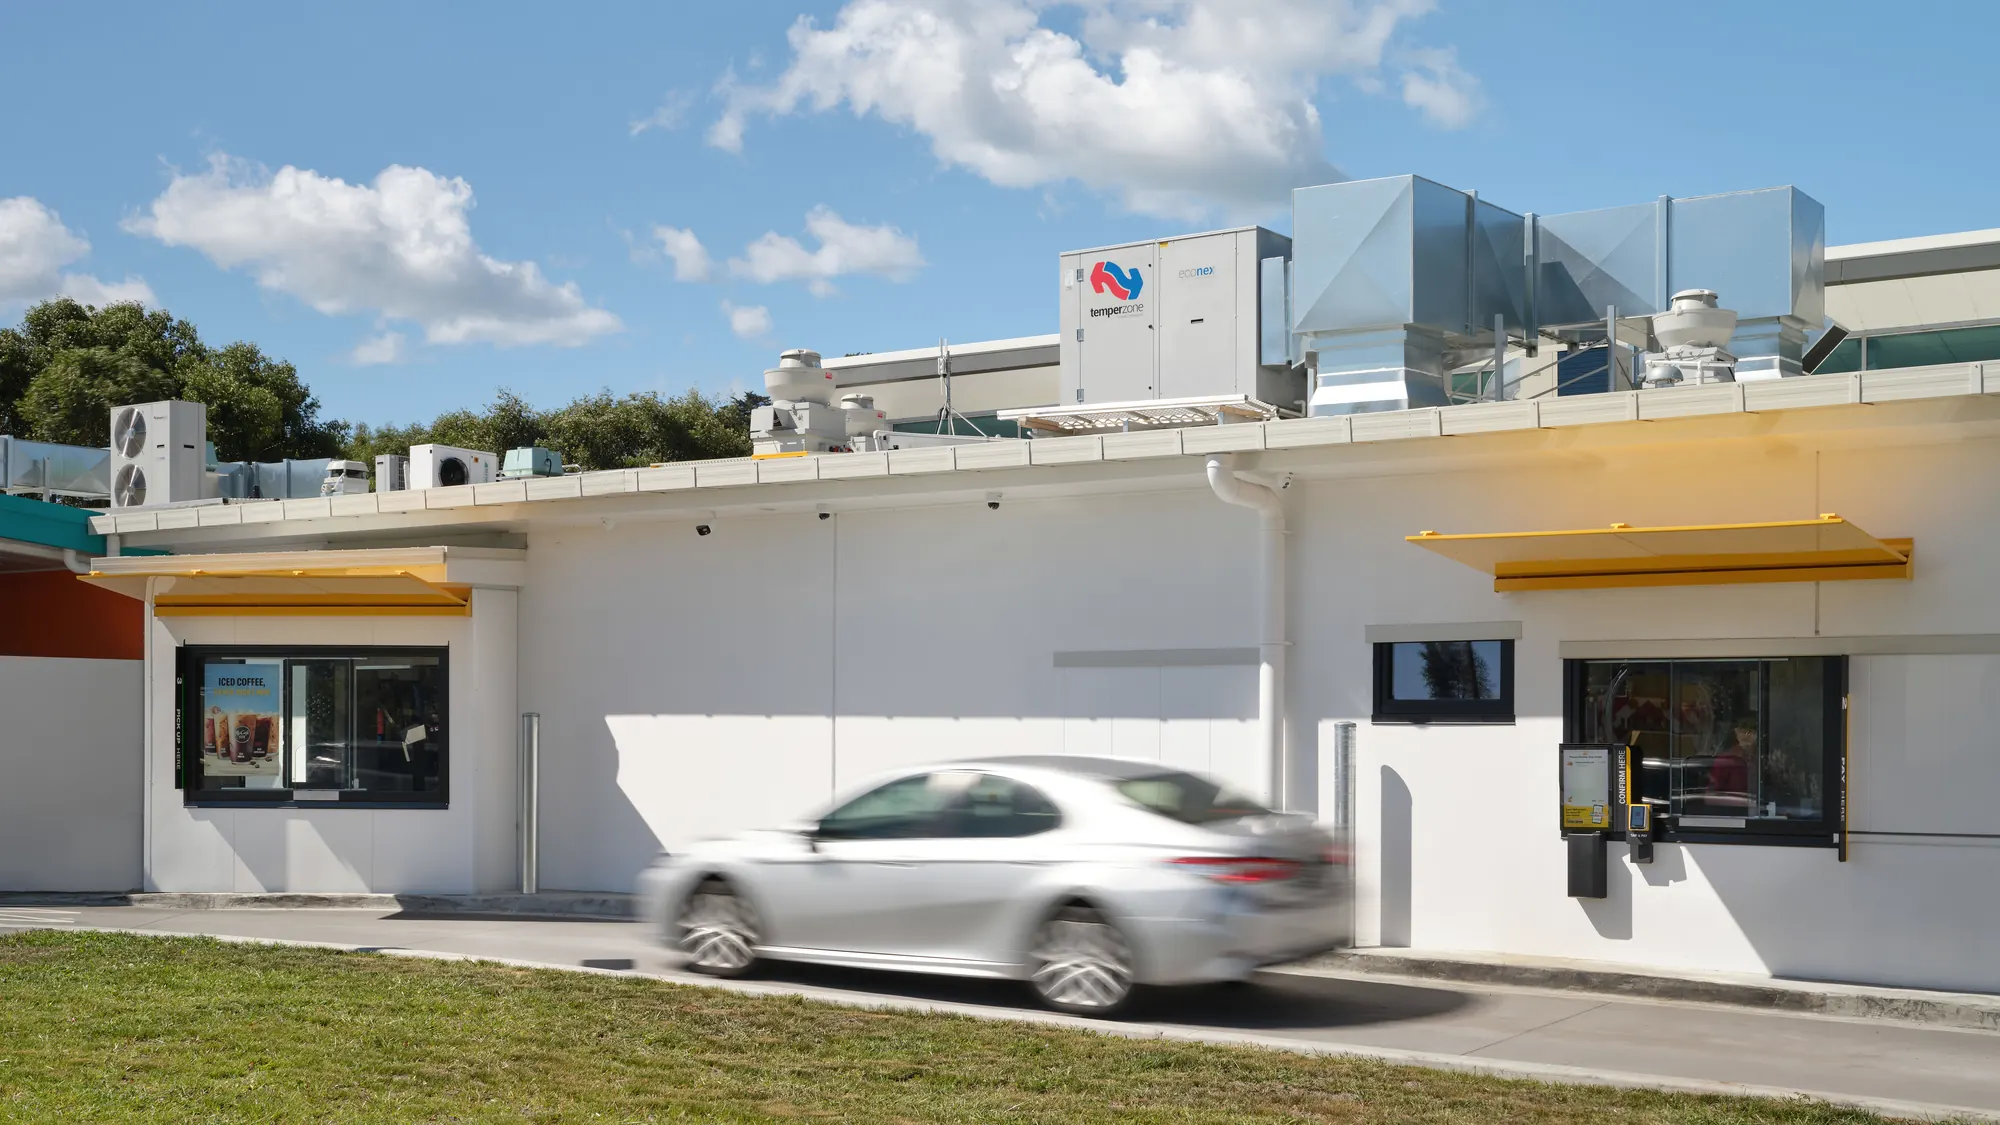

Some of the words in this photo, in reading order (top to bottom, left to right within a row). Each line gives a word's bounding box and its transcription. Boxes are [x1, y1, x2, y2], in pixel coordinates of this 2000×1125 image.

[1179, 266, 1215, 278] econex
[1090, 303, 1144, 318] temperzone
[176, 677, 183, 685] 3
[218, 677, 236, 687] ICED
[237, 677, 266, 688] COFFEE,
[1841, 696, 1848, 710] 2
[176, 731, 181, 744] UP
[1618, 750, 1626, 769] HERE
[1618, 770, 1626, 805] CONFIRM
